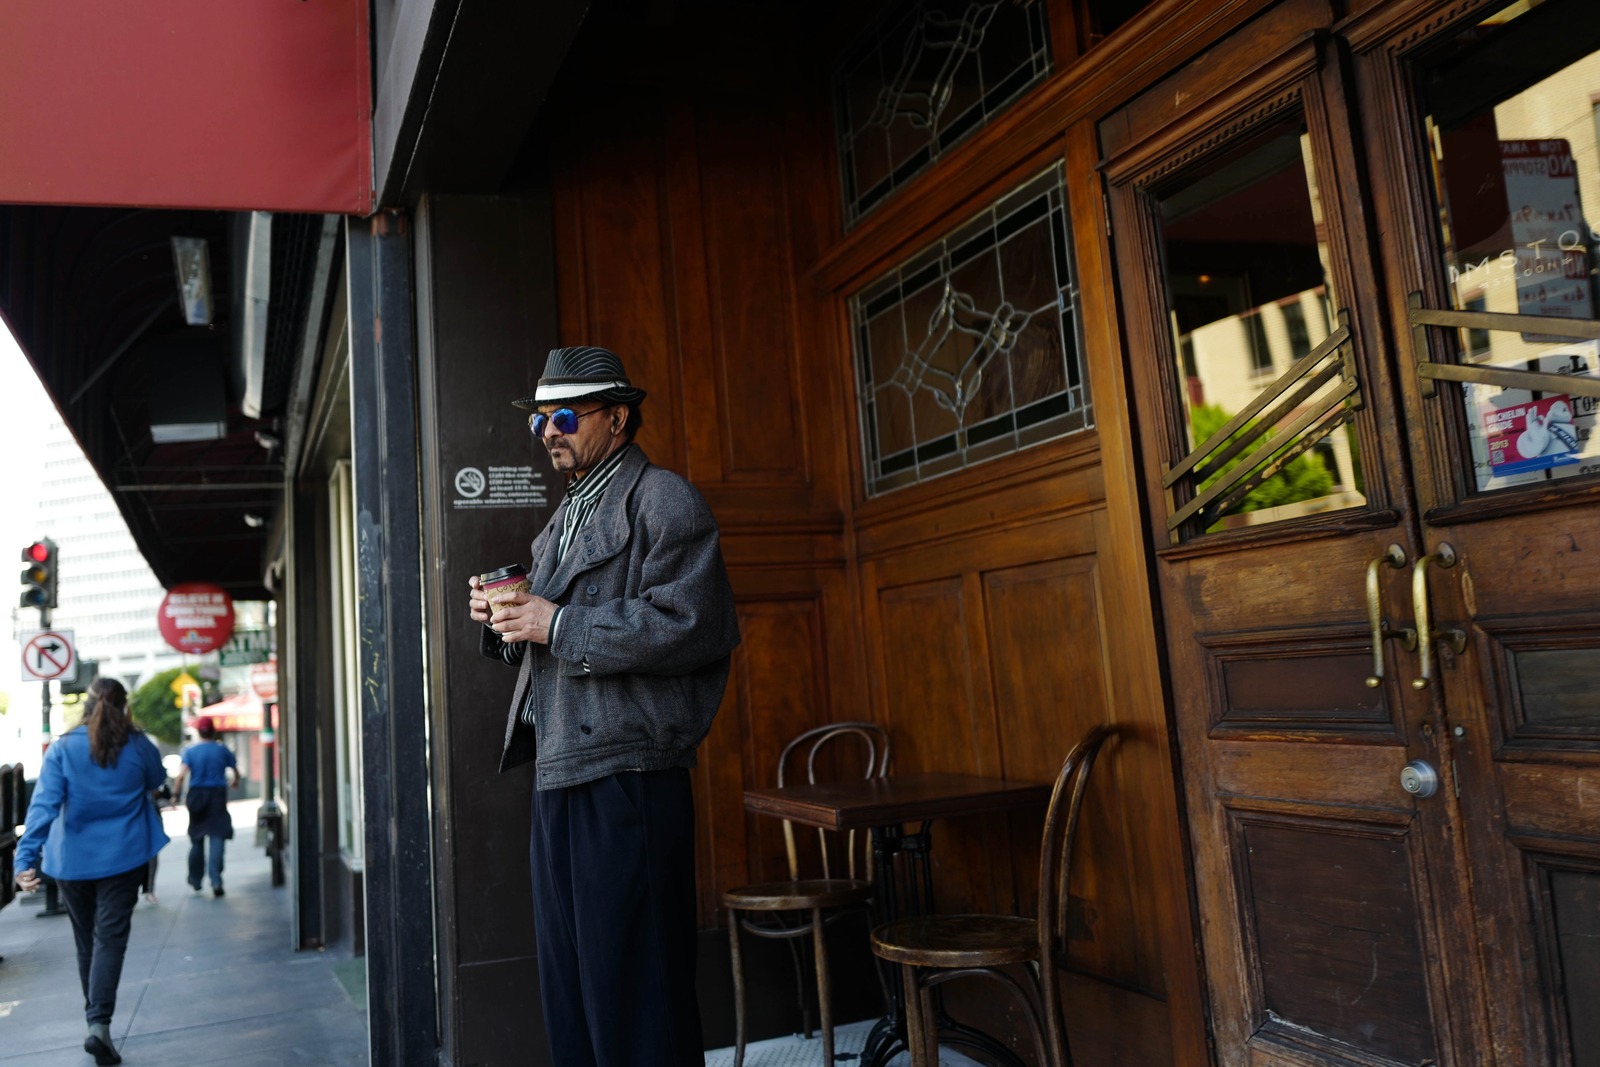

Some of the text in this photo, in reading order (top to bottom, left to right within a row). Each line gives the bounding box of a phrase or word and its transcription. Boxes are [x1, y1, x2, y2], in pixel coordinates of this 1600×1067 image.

[1486, 407, 1526, 424] MICHELIN
[1486, 420, 1514, 434] GUIDE
[1490, 440, 1509, 451] 2013
